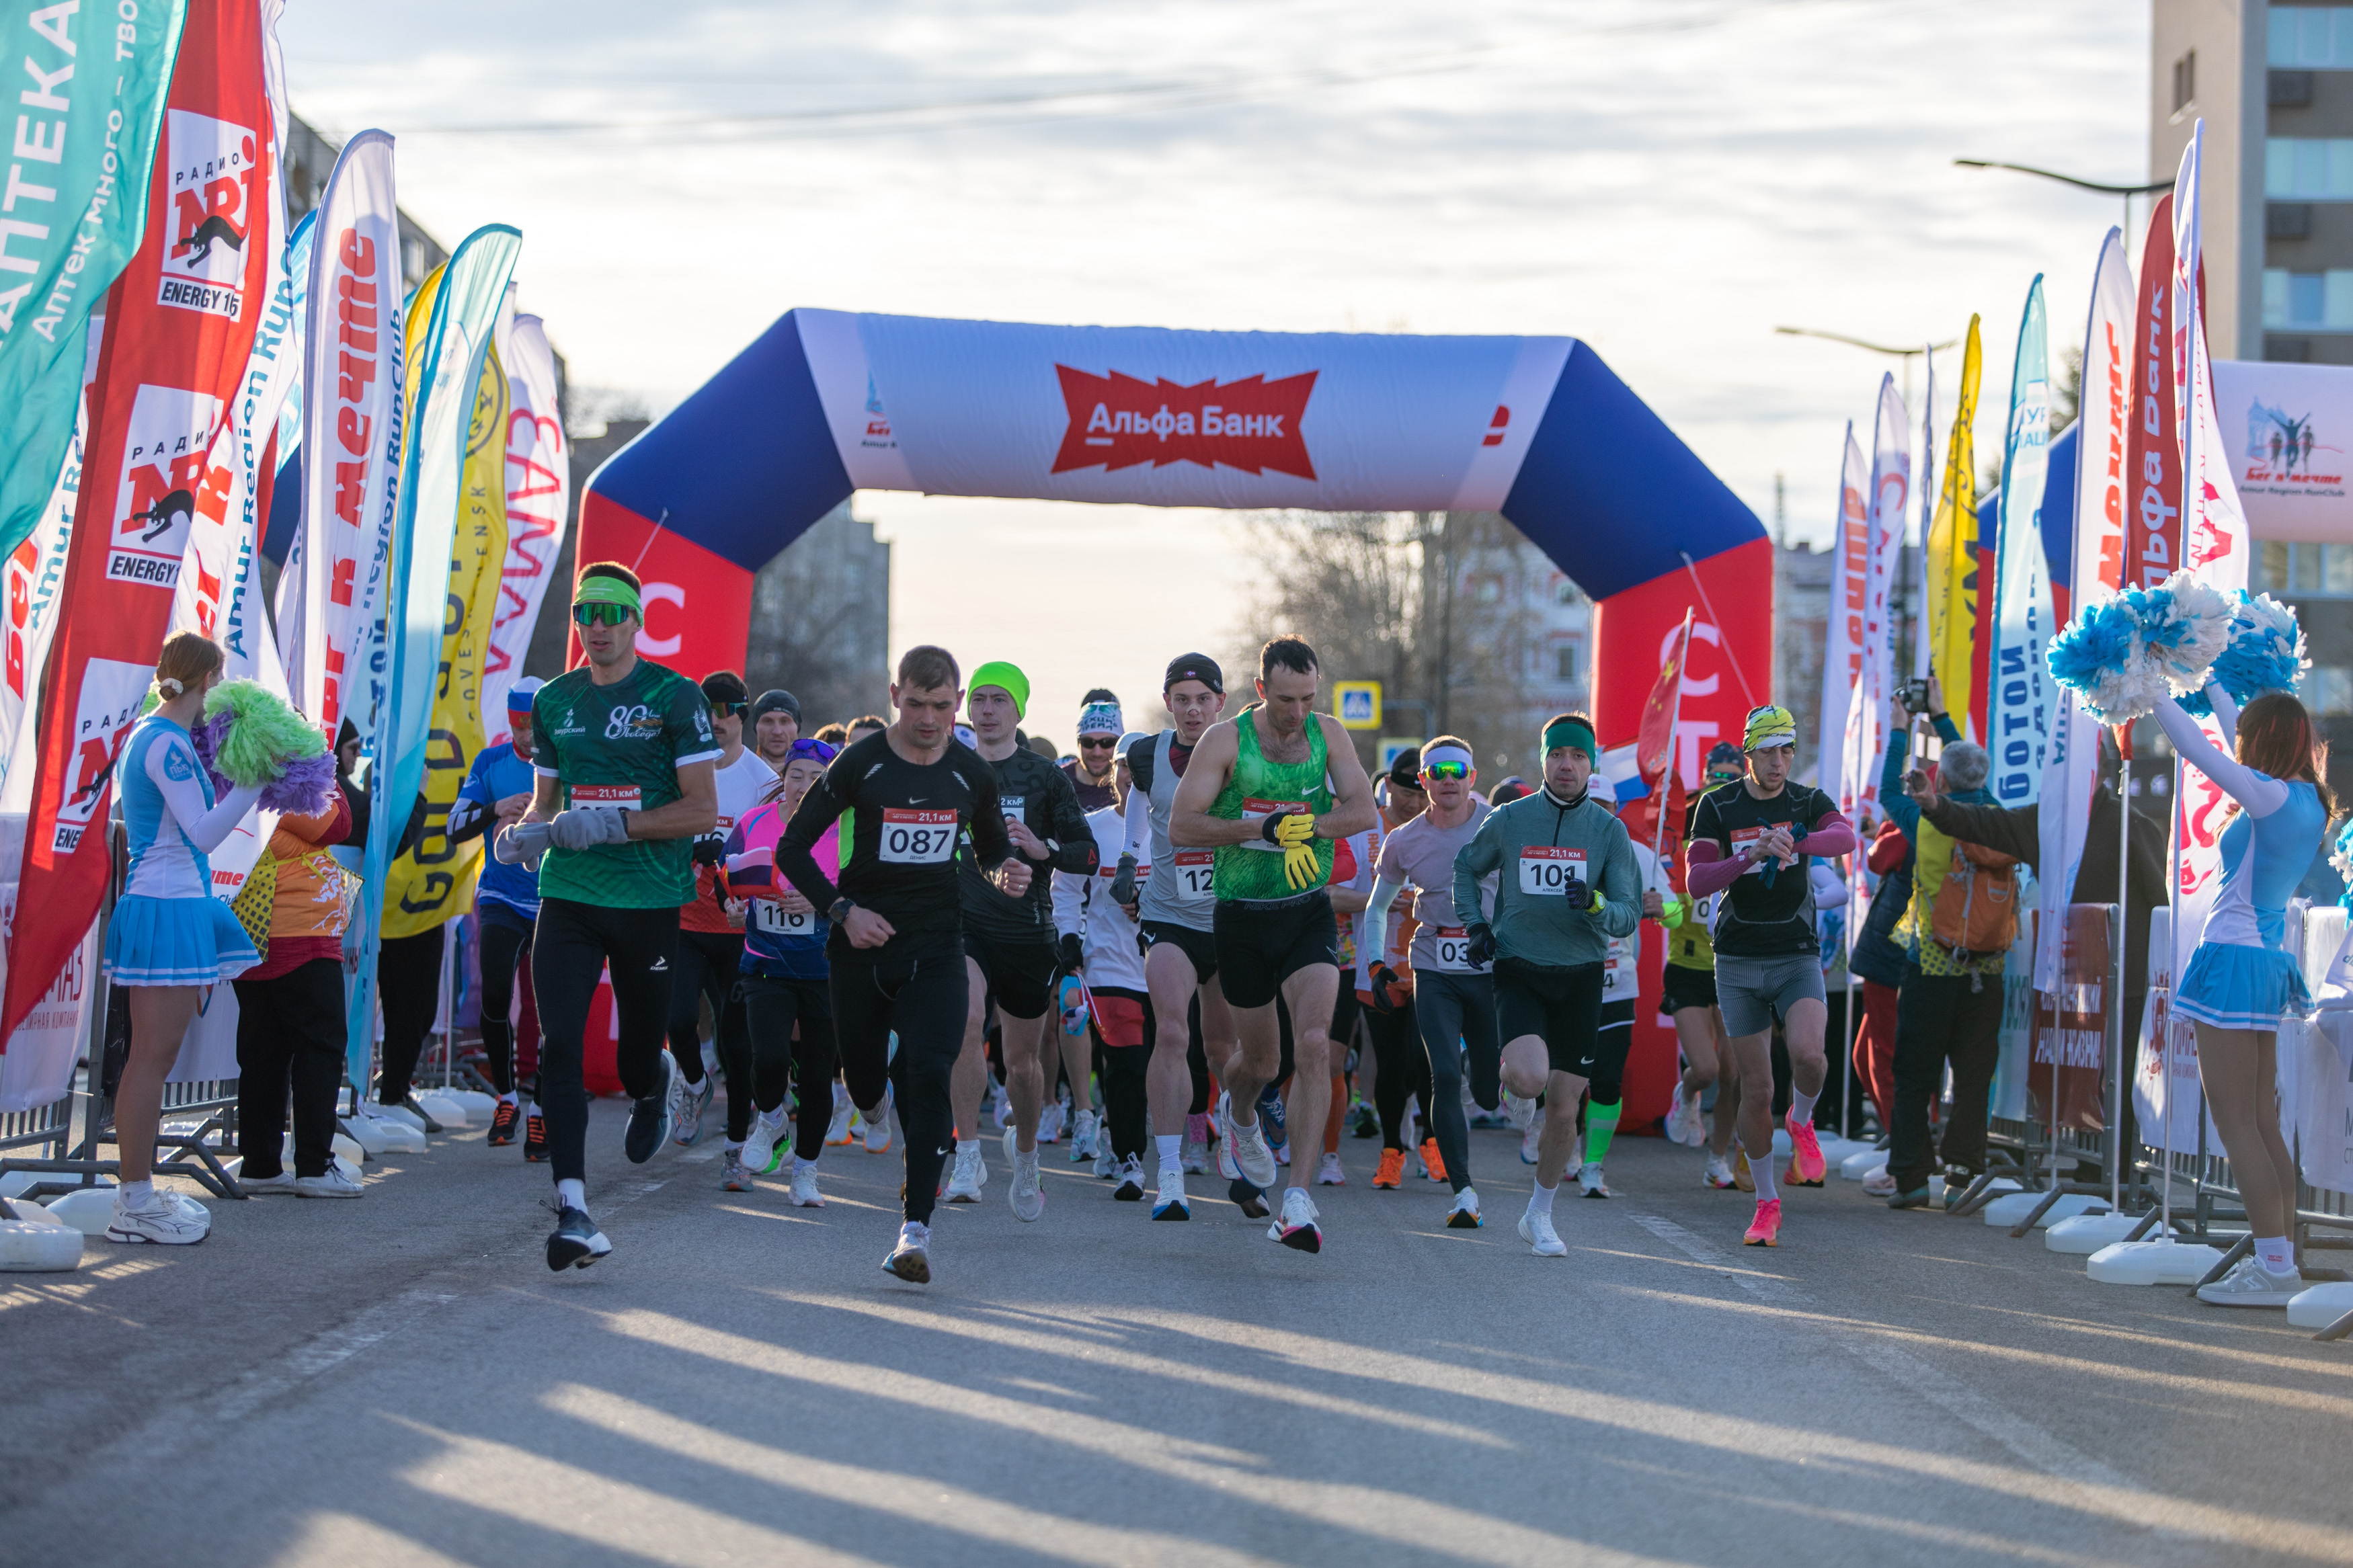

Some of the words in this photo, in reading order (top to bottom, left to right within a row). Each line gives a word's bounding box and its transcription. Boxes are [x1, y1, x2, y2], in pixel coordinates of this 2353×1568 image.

[0, 0, 80, 334] АПТЕКА
[175, 152, 239, 185] РАДИО
[161, 281, 221, 309] ENERGY
[386, 309, 403, 466] RunClub
[1086, 402, 1195, 444] Альфа
[1201, 405, 1285, 438] Банк
[132, 431, 204, 460] РАДИ
[2140, 451, 2178, 589] льфа
[31, 504, 74, 630] Amur
[110, 555, 177, 584] ENERGY
[223, 535, 252, 661] Amur
[598, 788, 616, 799] 21,1
[918, 813, 938, 823] 21,1
[889, 829, 950, 854] 087
[1550, 849, 1566, 858] 21,1
[764, 905, 805, 928] 116
[1281, 895, 1312, 909] PRO
